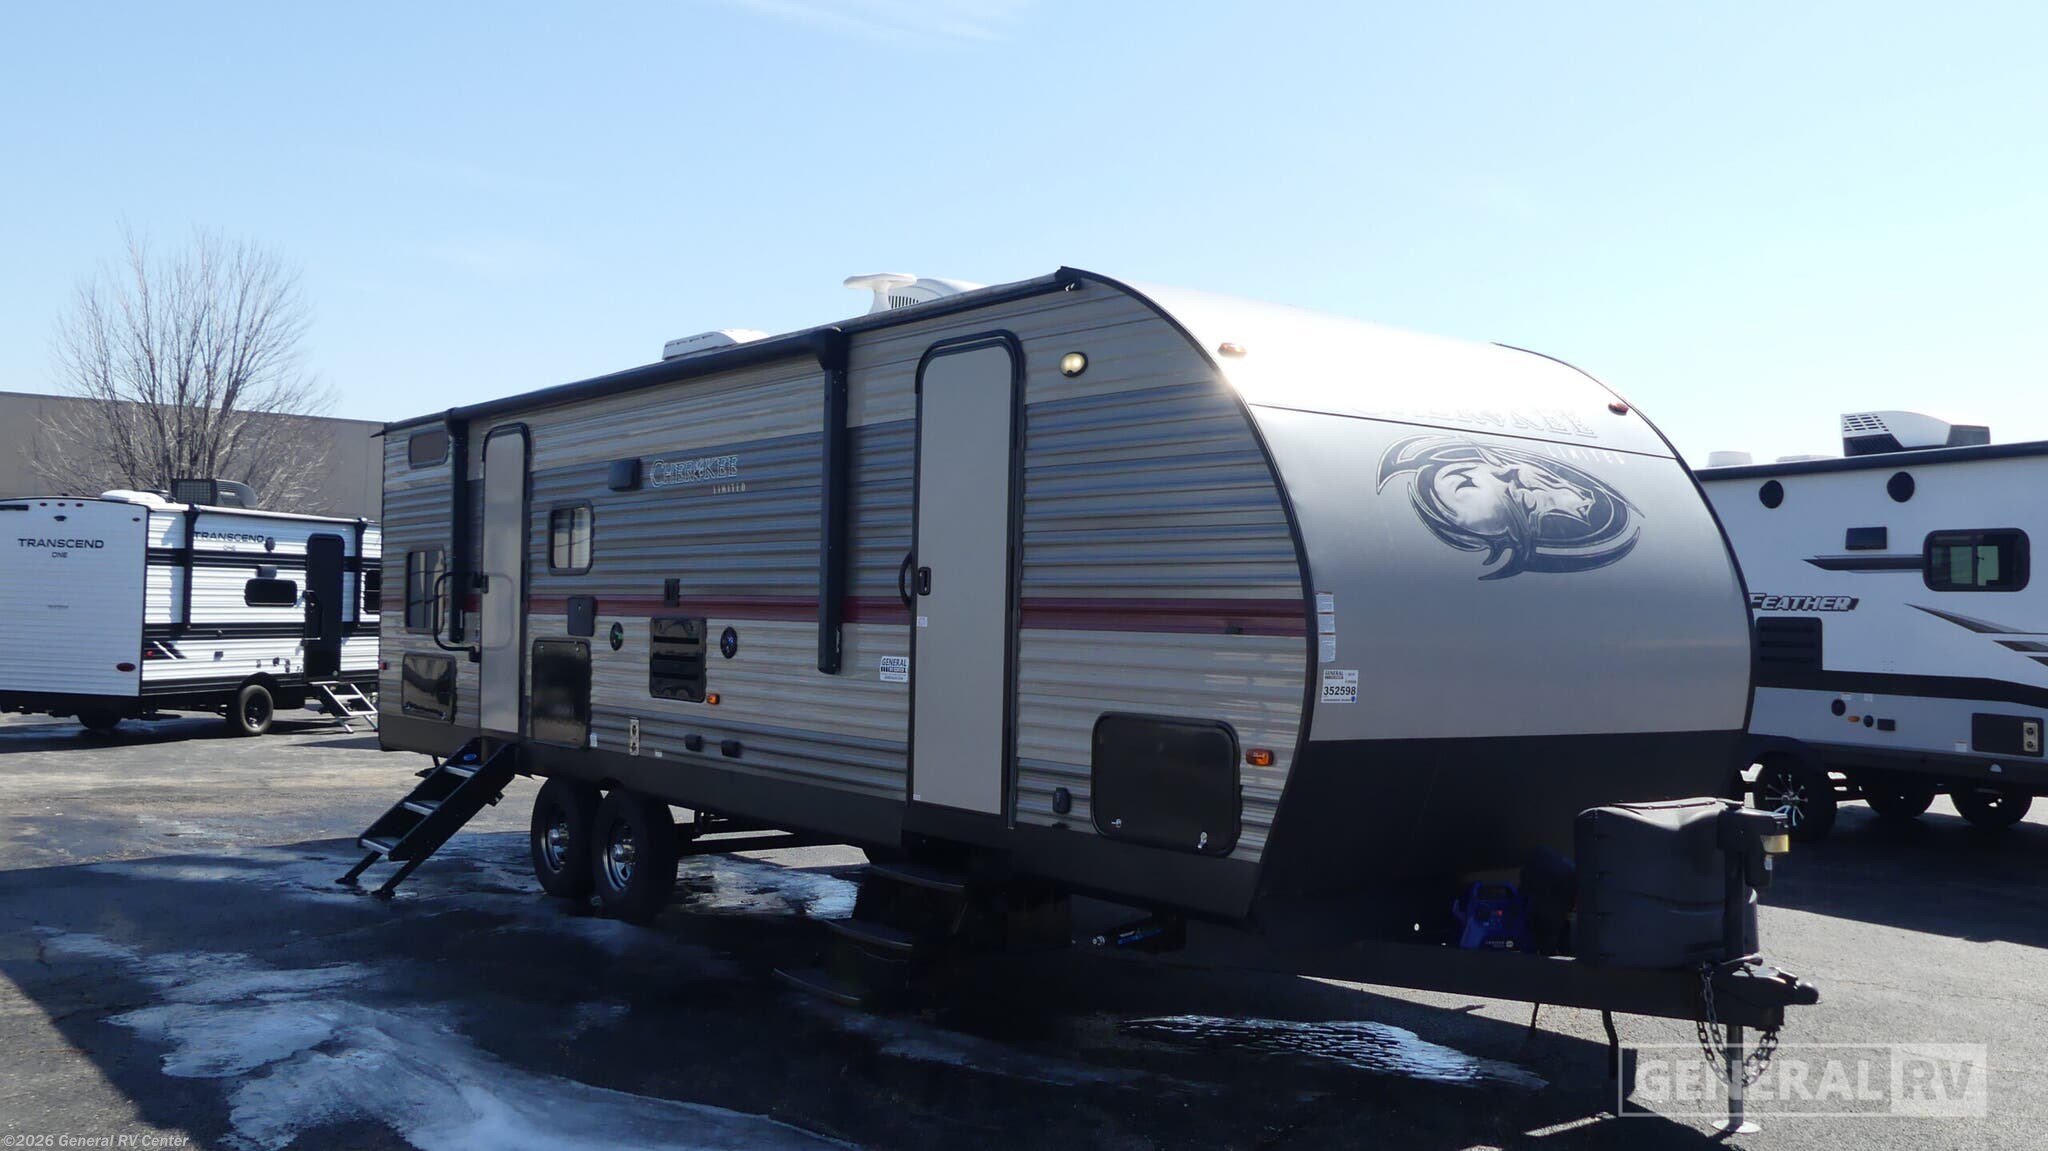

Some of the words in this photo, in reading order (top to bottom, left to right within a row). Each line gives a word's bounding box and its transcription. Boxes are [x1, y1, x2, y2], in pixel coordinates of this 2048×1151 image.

[650, 454, 740, 488] CHEROKEE
[712, 482, 747, 495] LIMITED
[17, 538, 105, 549] TRANSCEND
[193, 530, 265, 544] TRANSCEND
[1749, 593, 1853, 612] FEATHER
[1323, 686, 1357, 696] 352598
